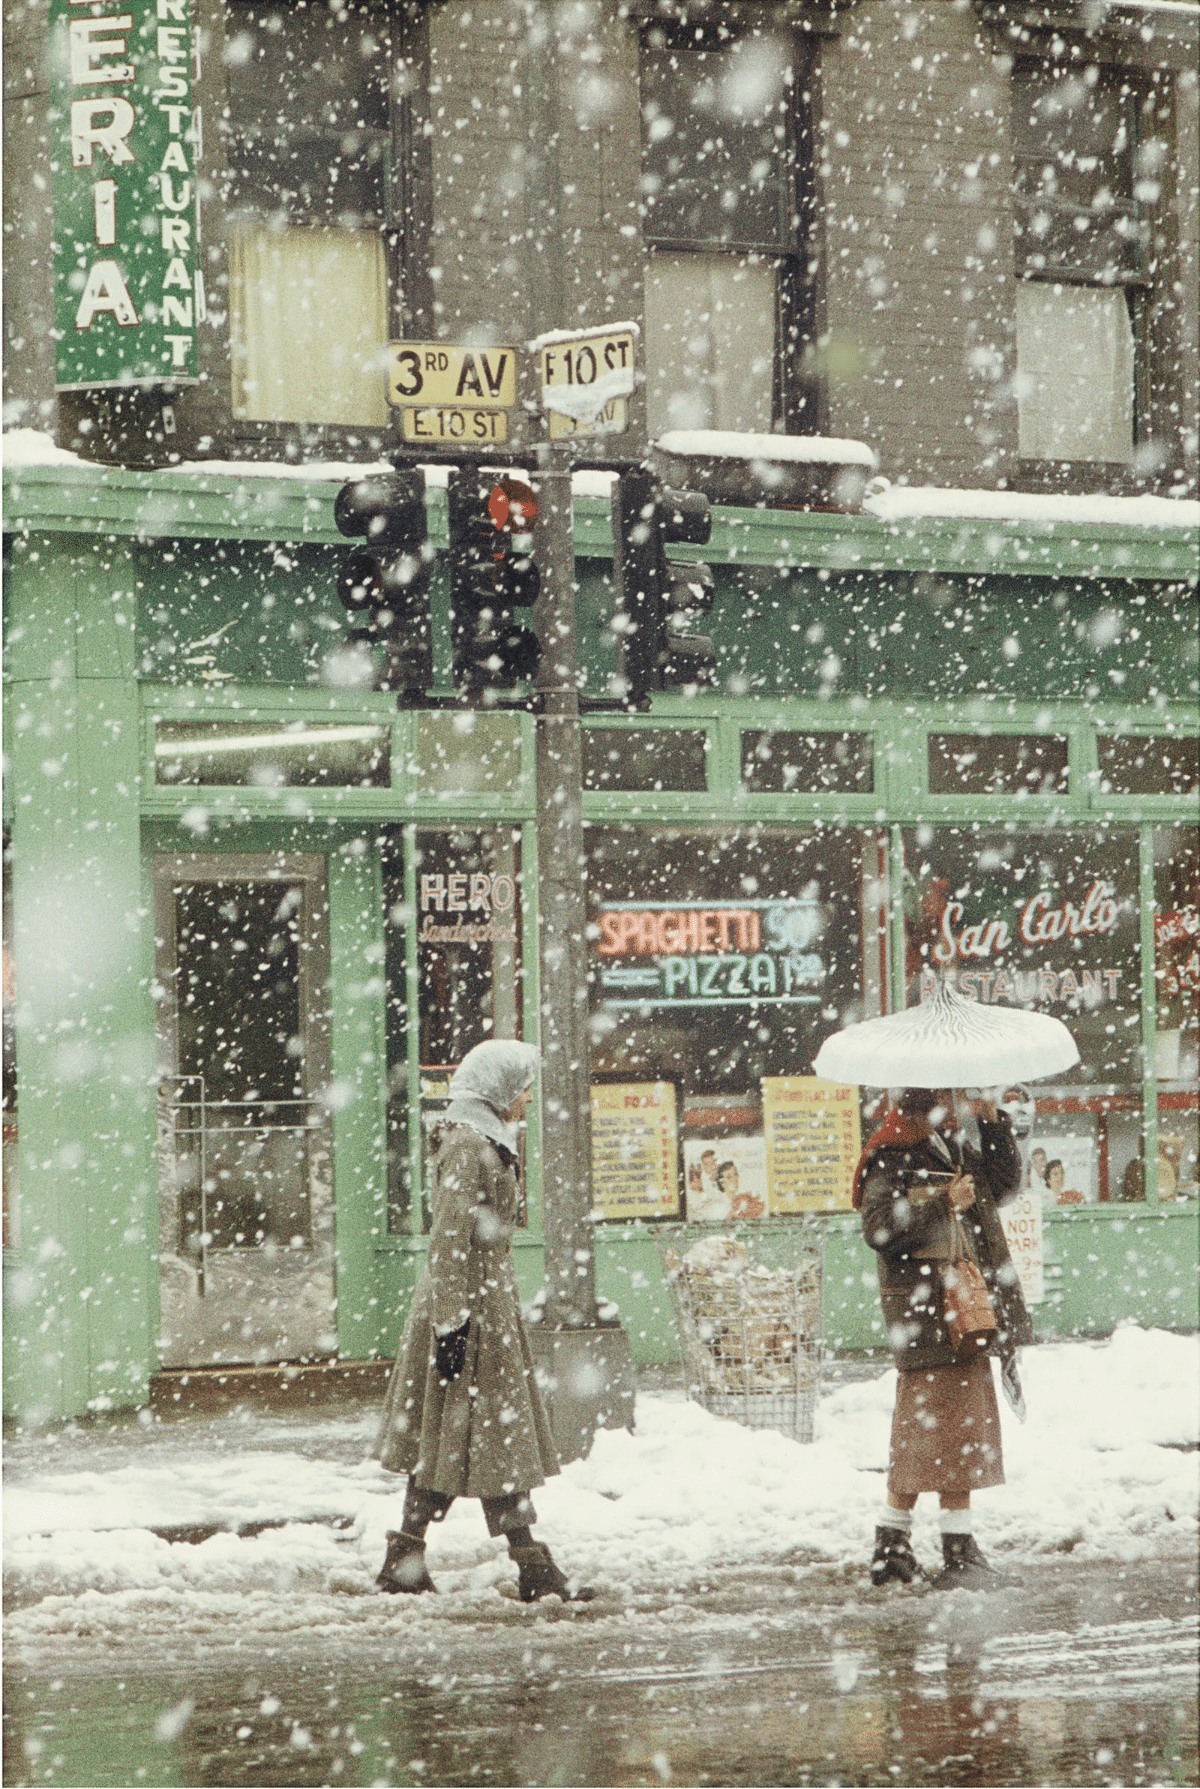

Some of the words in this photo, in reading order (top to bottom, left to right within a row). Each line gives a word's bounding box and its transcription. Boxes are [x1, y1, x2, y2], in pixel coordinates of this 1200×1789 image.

[68, 0, 141, 330] ERIA
[156, 0, 193, 366] RESTAURANT
[395, 350, 449, 397] 3RD
[455, 353, 508, 397] AV
[563, 345, 597, 385] 10
[604, 340, 629, 370] ST
[472, 411, 499, 437] ST
[421, 873, 516, 912] HERO
[598, 910, 760, 954] SPAGHETTI
[932, 901, 1012, 961] San
[1020, 879, 1120, 945] Carlo
[665, 953, 776, 996] PIZZA
[919, 968, 1123, 1002] RSTAURANT
[1006, 1237, 1040, 1252] PARK
[1007, 1219, 1037, 1234] NOT
